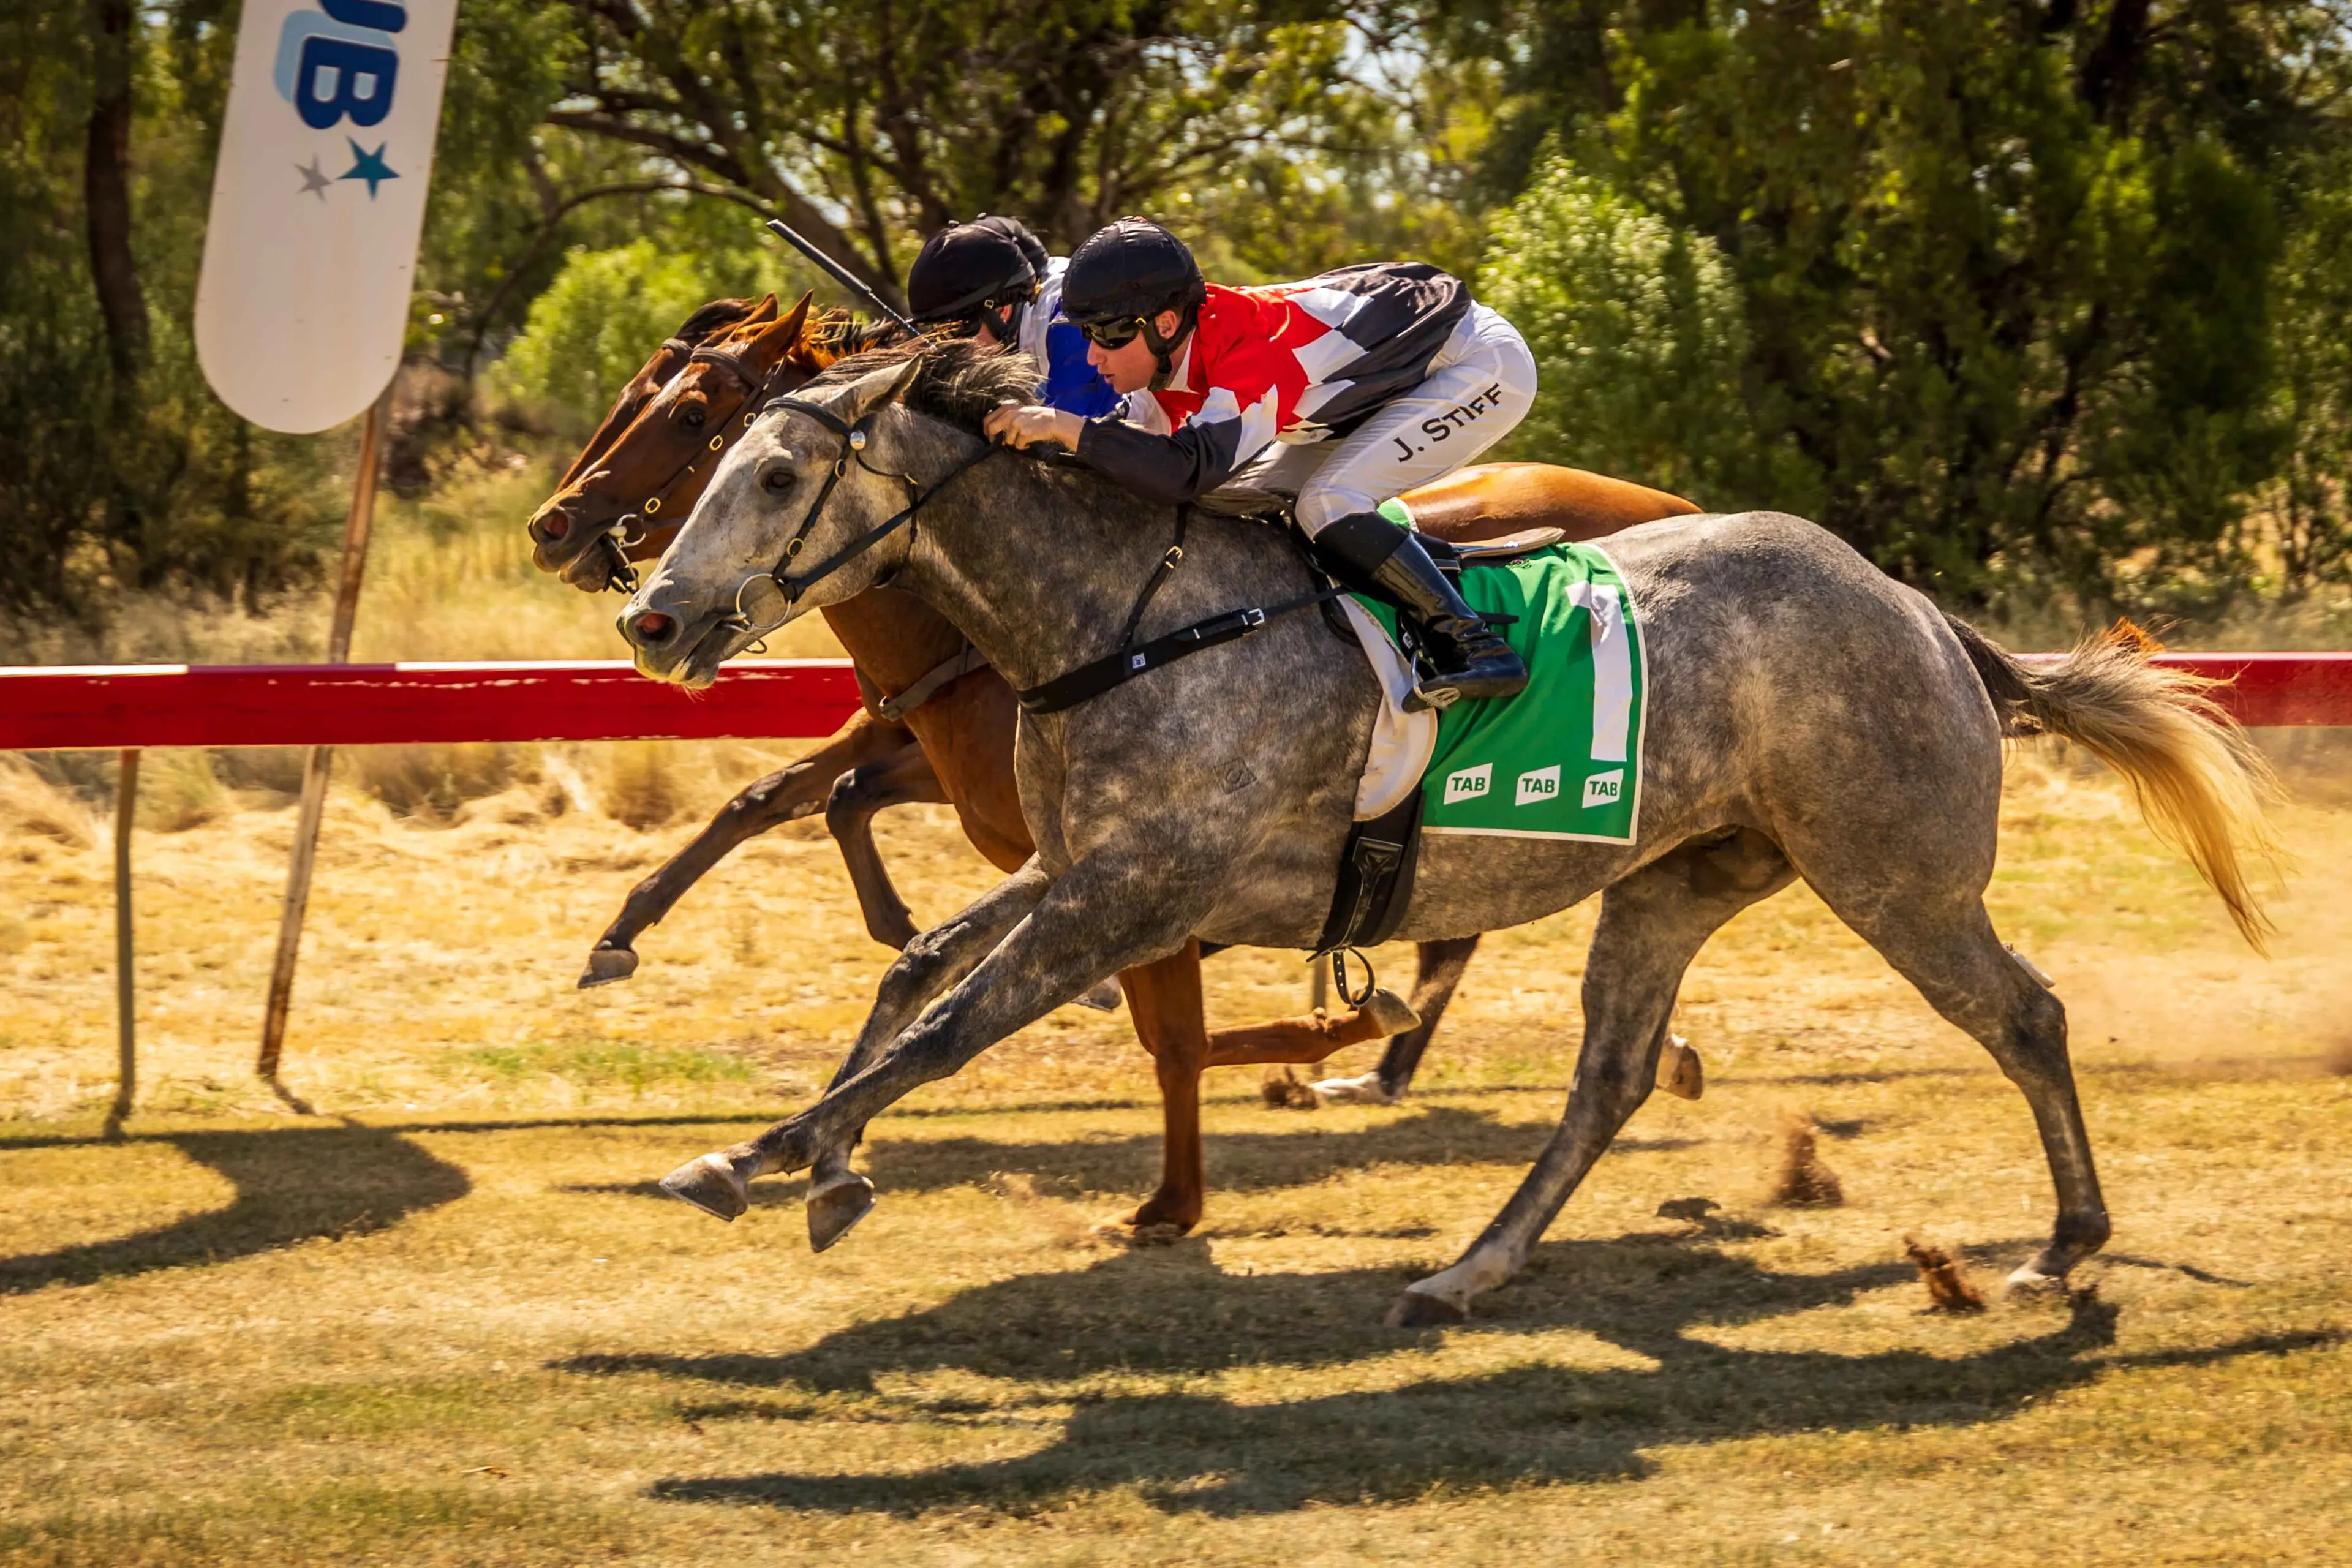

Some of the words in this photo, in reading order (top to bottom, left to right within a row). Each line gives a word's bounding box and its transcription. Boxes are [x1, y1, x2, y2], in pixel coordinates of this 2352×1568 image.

[1393, 437, 1425, 463] J.
[1421, 382, 1502, 442] STIFF
[1565, 580, 1633, 762] 1
[1452, 777, 1486, 791] TAB
[1522, 778, 1555, 794] TAB
[1589, 780, 1618, 797] TAB
